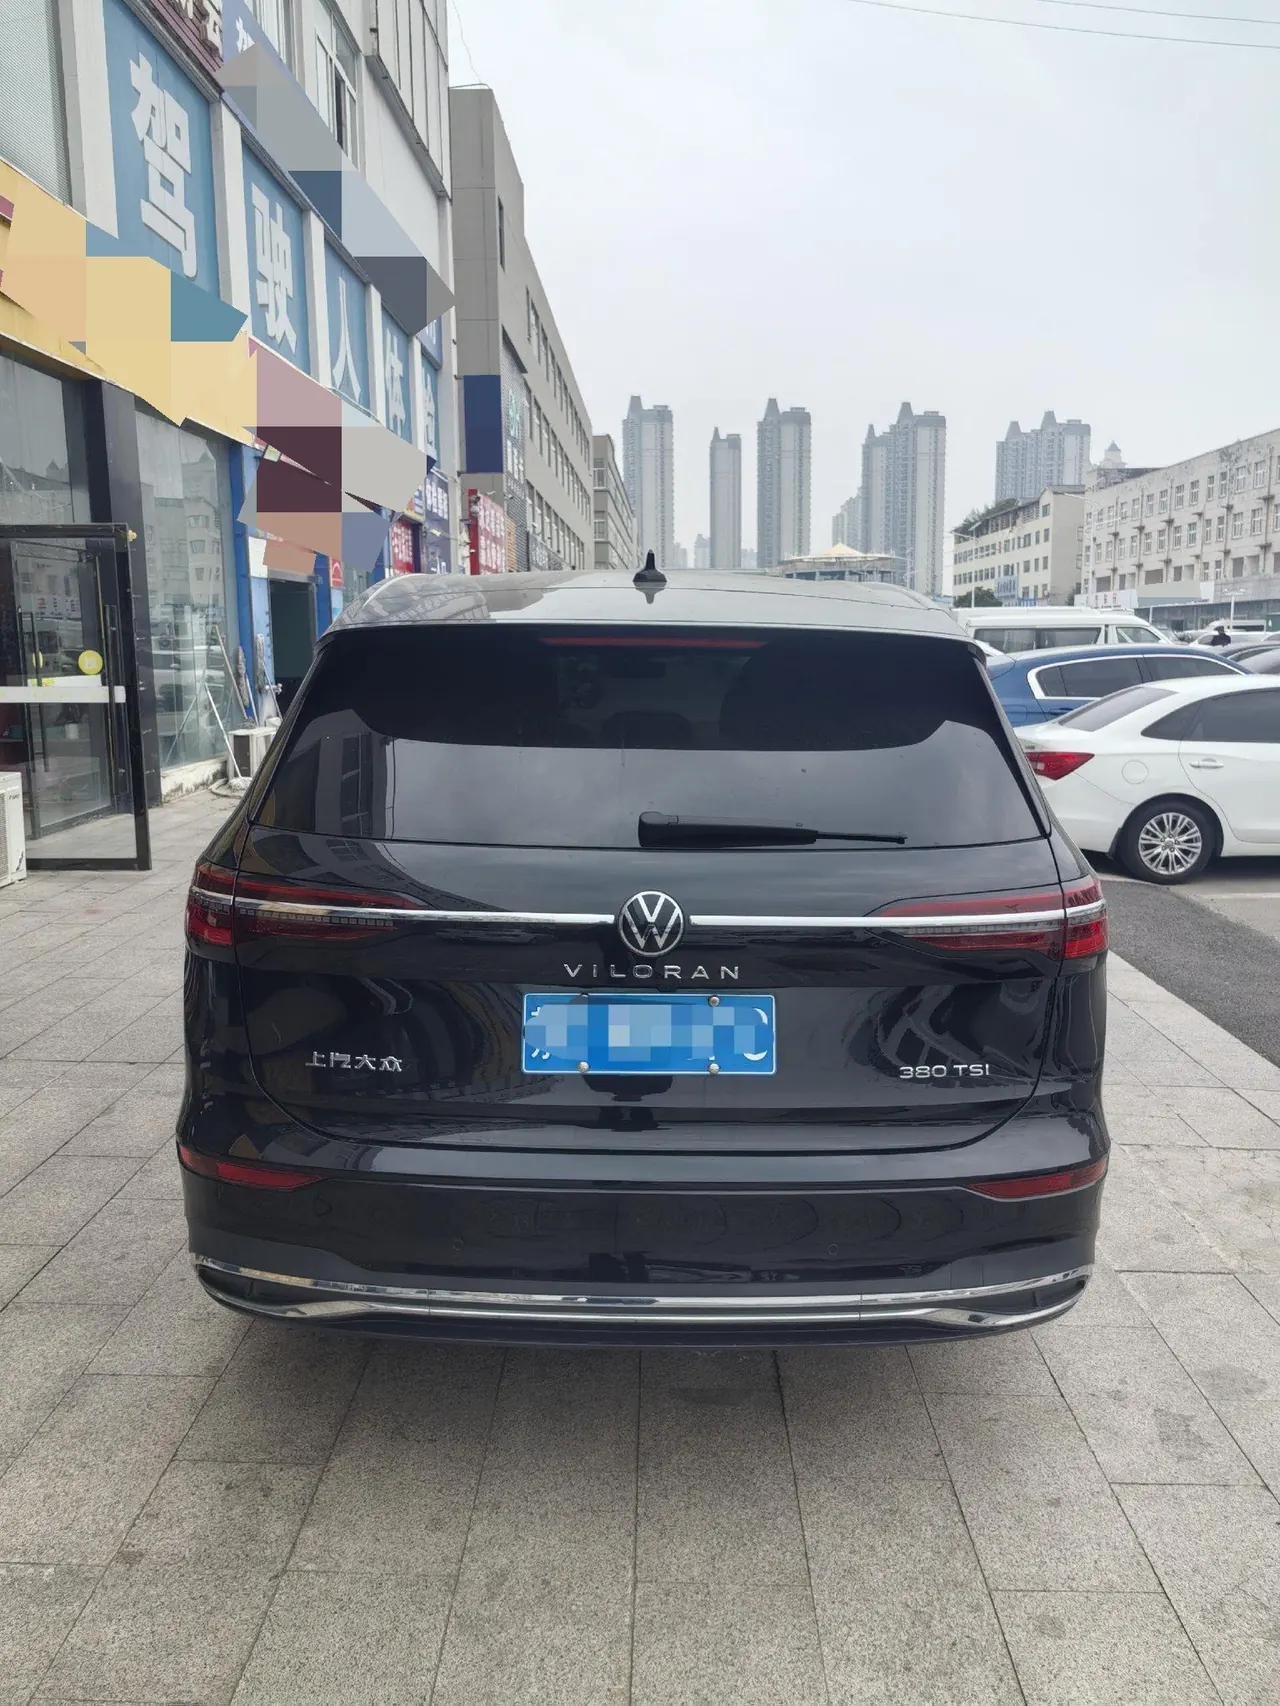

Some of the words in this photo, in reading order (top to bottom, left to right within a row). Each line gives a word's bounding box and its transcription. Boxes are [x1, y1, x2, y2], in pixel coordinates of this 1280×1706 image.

[564, 963, 739, 980] VILORAN
[305, 1051, 402, 1072] 上汽大众
[899, 1065, 947, 1079] 380
[953, 1063, 990, 1077] TSI
